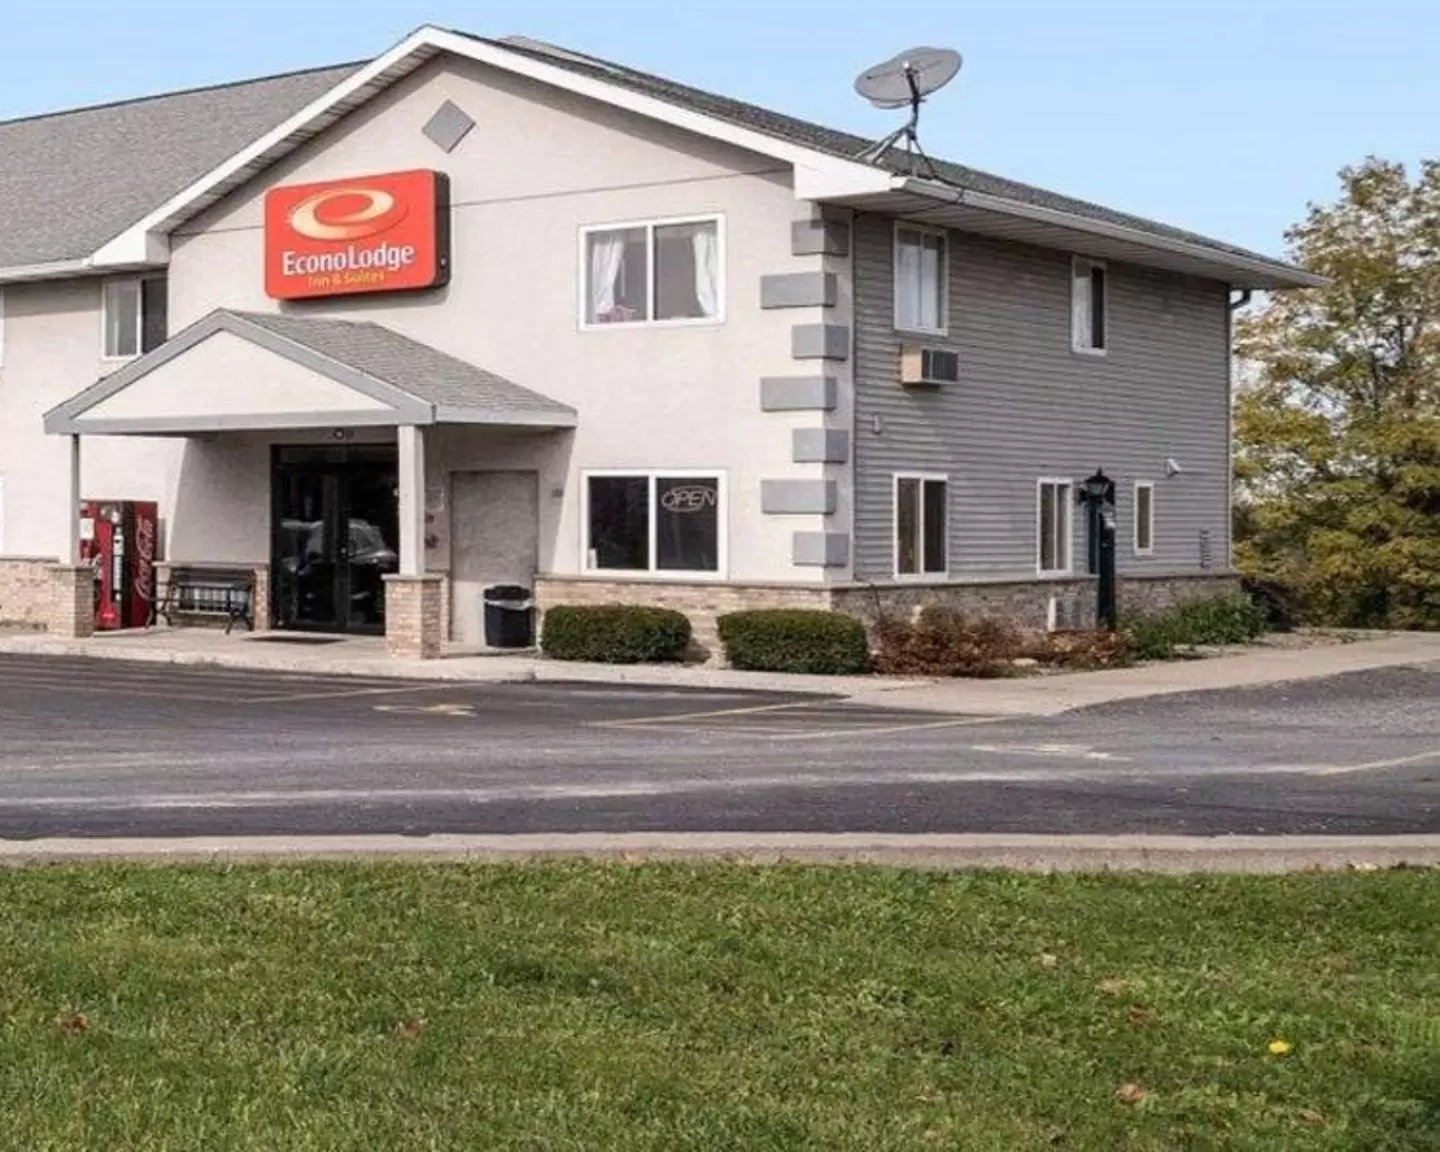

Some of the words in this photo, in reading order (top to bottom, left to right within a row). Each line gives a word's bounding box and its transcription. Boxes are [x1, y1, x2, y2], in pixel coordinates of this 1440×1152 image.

[282, 242, 416, 276] EconoLodge
[308, 274, 330, 289] Inn
[662, 489, 715, 508] OPEN
